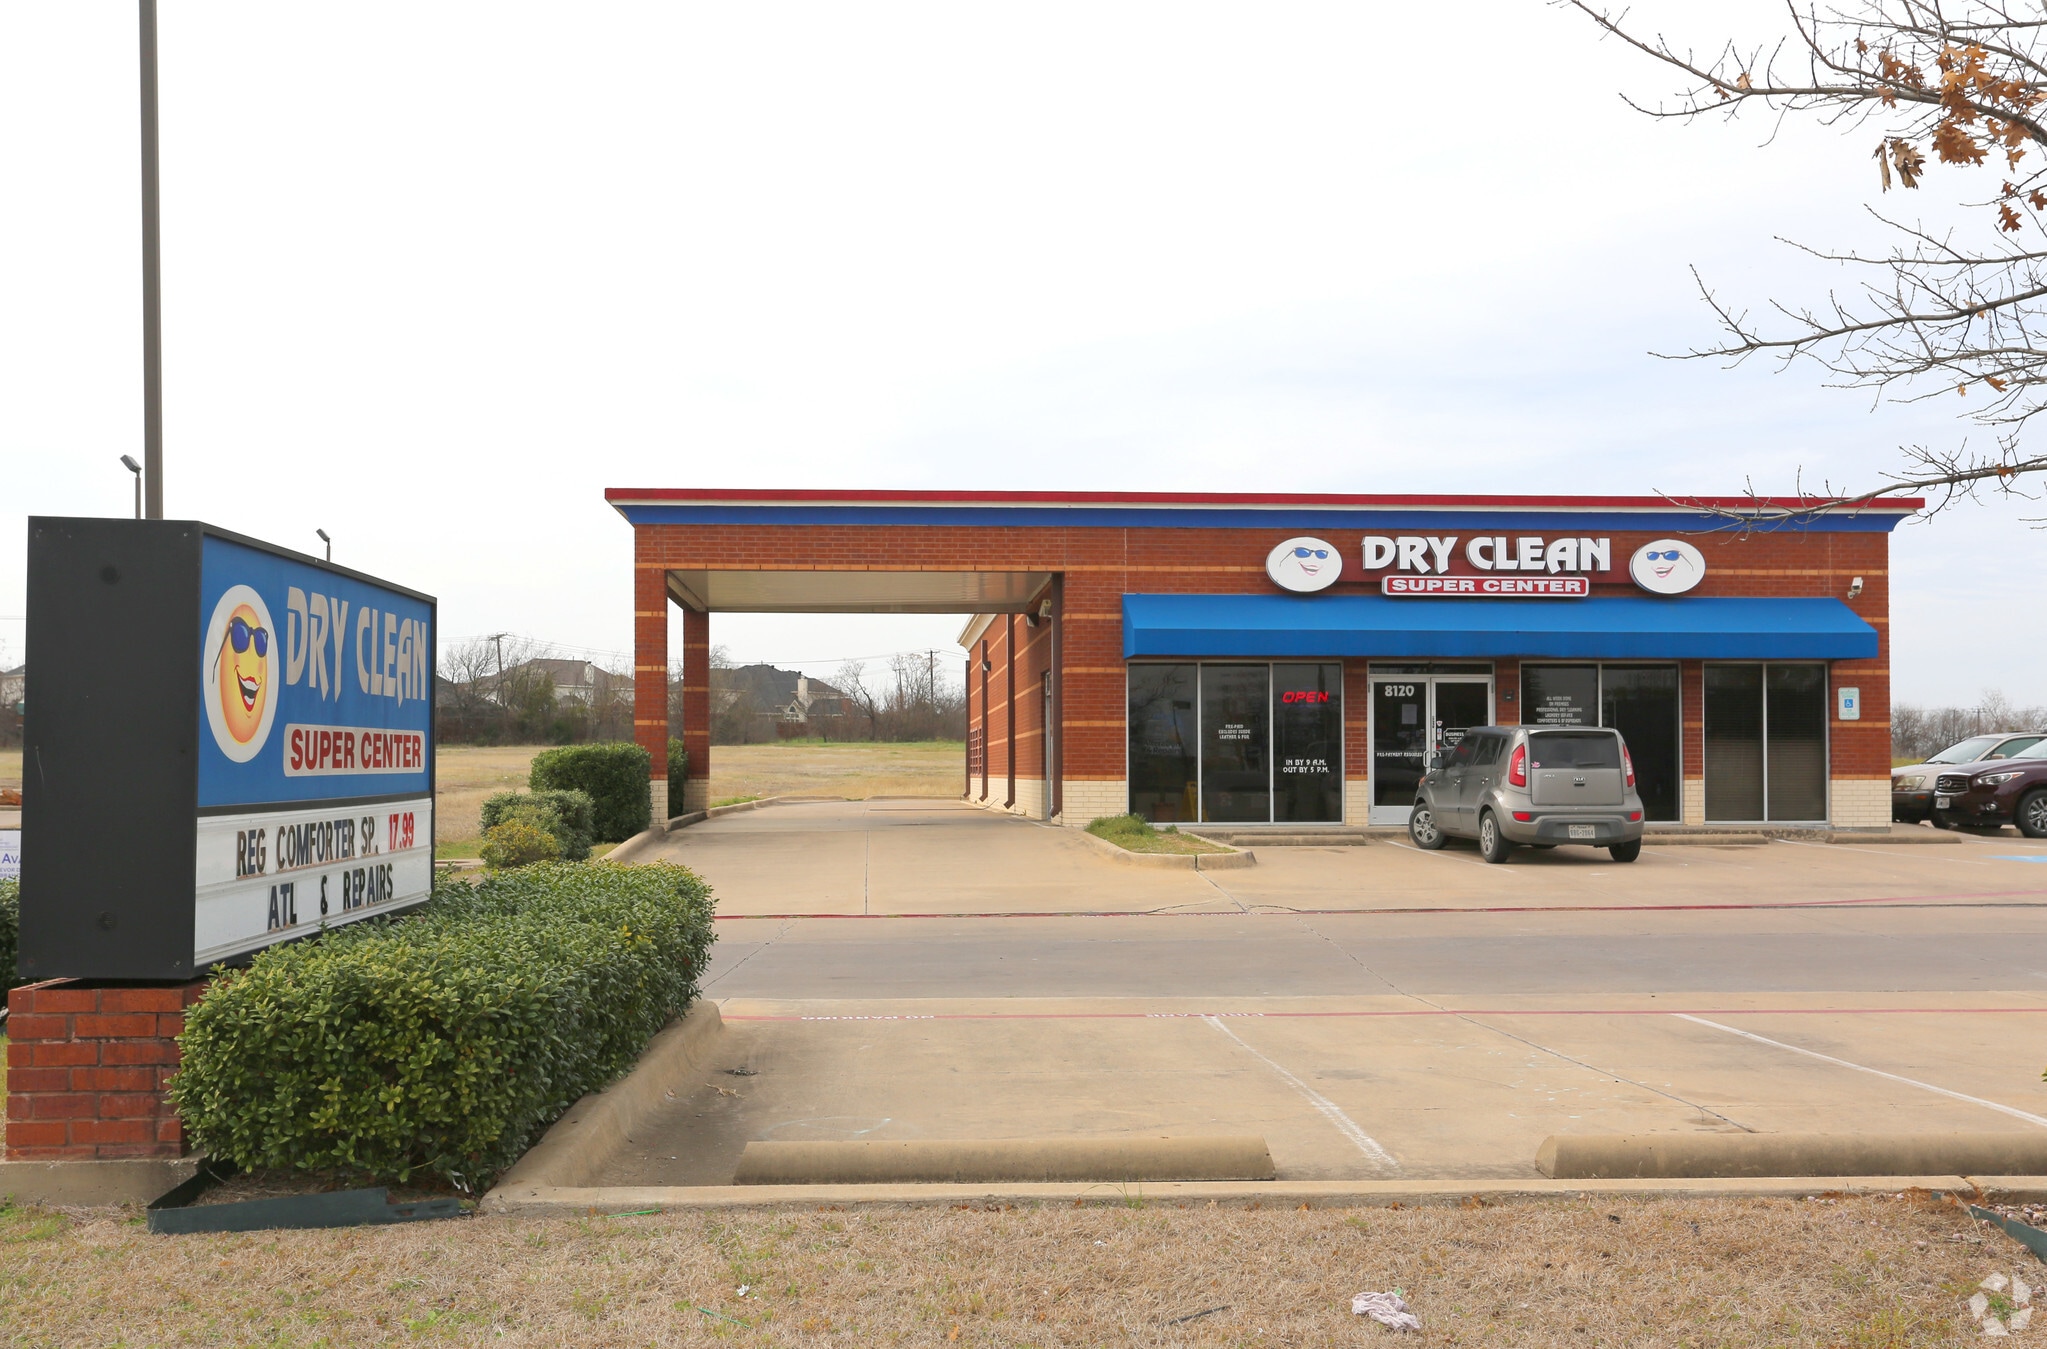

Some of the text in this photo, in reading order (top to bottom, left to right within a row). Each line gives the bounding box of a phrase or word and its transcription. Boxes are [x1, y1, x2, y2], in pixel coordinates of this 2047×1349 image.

[1361, 536, 1611, 574] DRY CLEAN
[1391, 579, 1581, 594] SUPER CENTER
[286, 586, 427, 707] DRY CLEAN
[1282, 691, 1329, 703] OPEN
[1384, 685, 1415, 697] 8120
[290, 728, 421, 771] SUPER CENTER
[236, 811, 415, 877] REG COMFORTER SP. 17.99
[267, 863, 394, 931] ATL & REPAIRS
